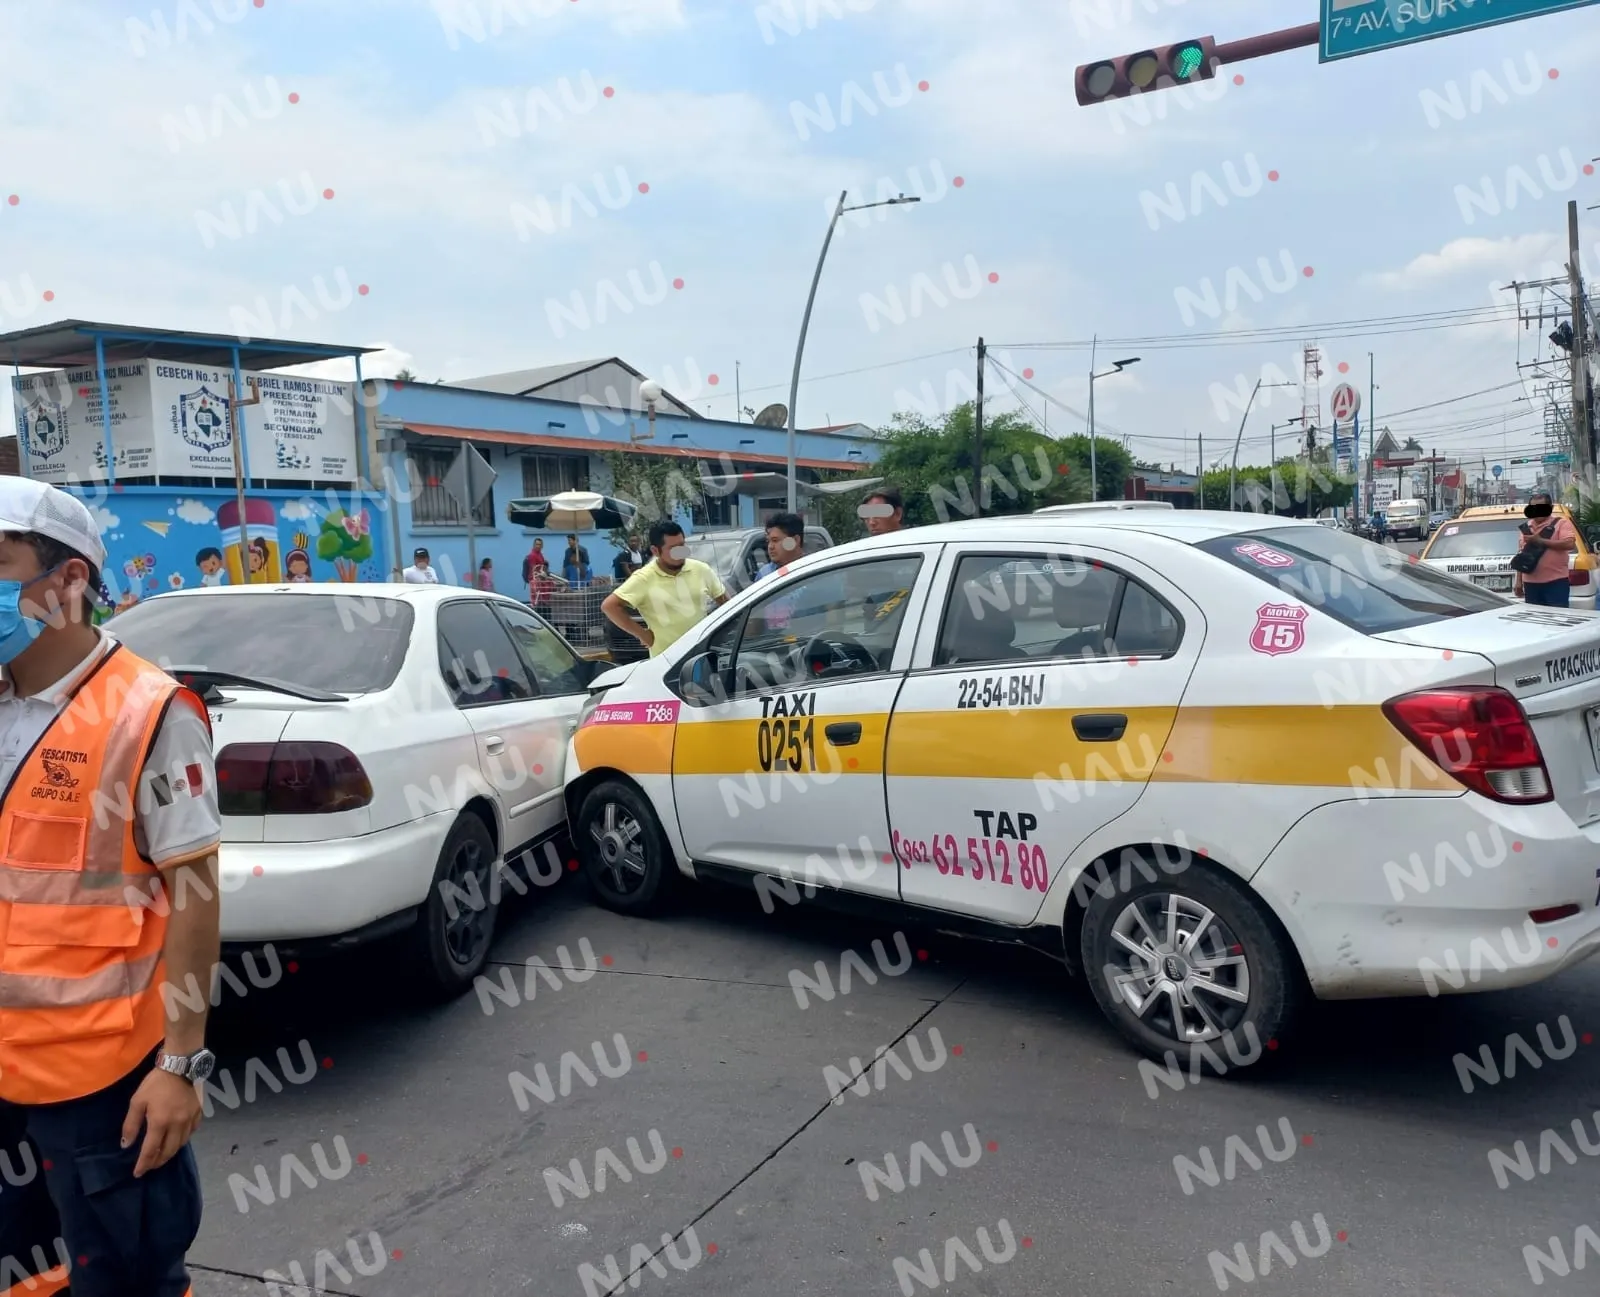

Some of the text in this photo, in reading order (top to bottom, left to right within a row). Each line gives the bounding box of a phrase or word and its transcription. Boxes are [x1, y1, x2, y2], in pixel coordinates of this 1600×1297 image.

[1354, 7, 1390, 34] AV.
[157, 366, 193, 381] CEBECH
[213, 372, 219, 383] 3
[283, 379, 312, 393] RAMOS
[263, 391, 323, 403] PREESCOLAR
[273, 408, 318, 419] PRIMARIA
[264, 423, 323, 436] SECUNDARIA
[189, 455, 232, 463] EXCELENCIA
[1266, 608, 1298, 618] MOVIL
[1260, 624, 1296, 648] 15
[957, 674, 1045, 709] 22-54-BHJ
[759, 692, 817, 718] TAXI
[40, 748, 88, 765] RESCATISTA
[758, 718, 816, 772] 0251
[31, 786, 58, 800] GRUPO
[973, 809, 1037, 841] TAP
[902, 834, 1048, 893] 962 62 512 80
